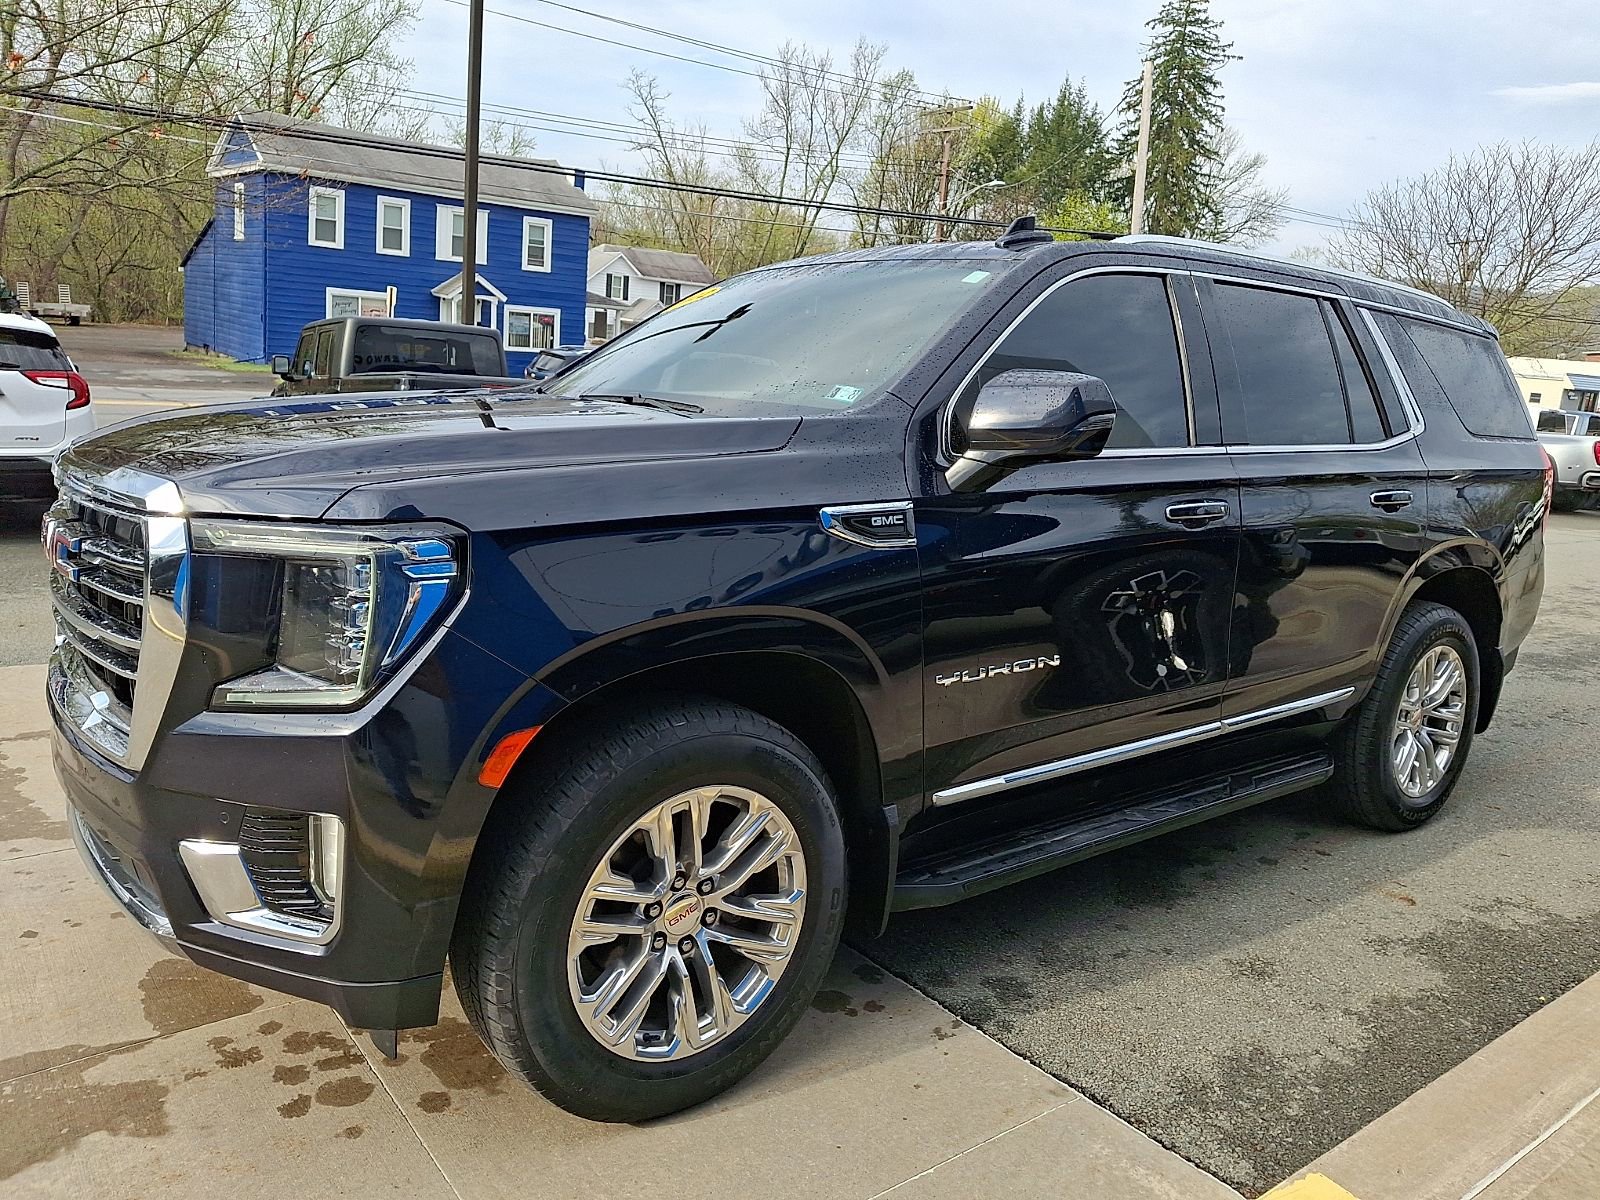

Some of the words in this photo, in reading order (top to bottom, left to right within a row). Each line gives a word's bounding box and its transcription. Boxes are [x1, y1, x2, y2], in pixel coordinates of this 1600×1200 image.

[871, 515, 904, 526] GMC
[935, 655, 1060, 686] YUKON
[668, 902, 699, 927] GMC
